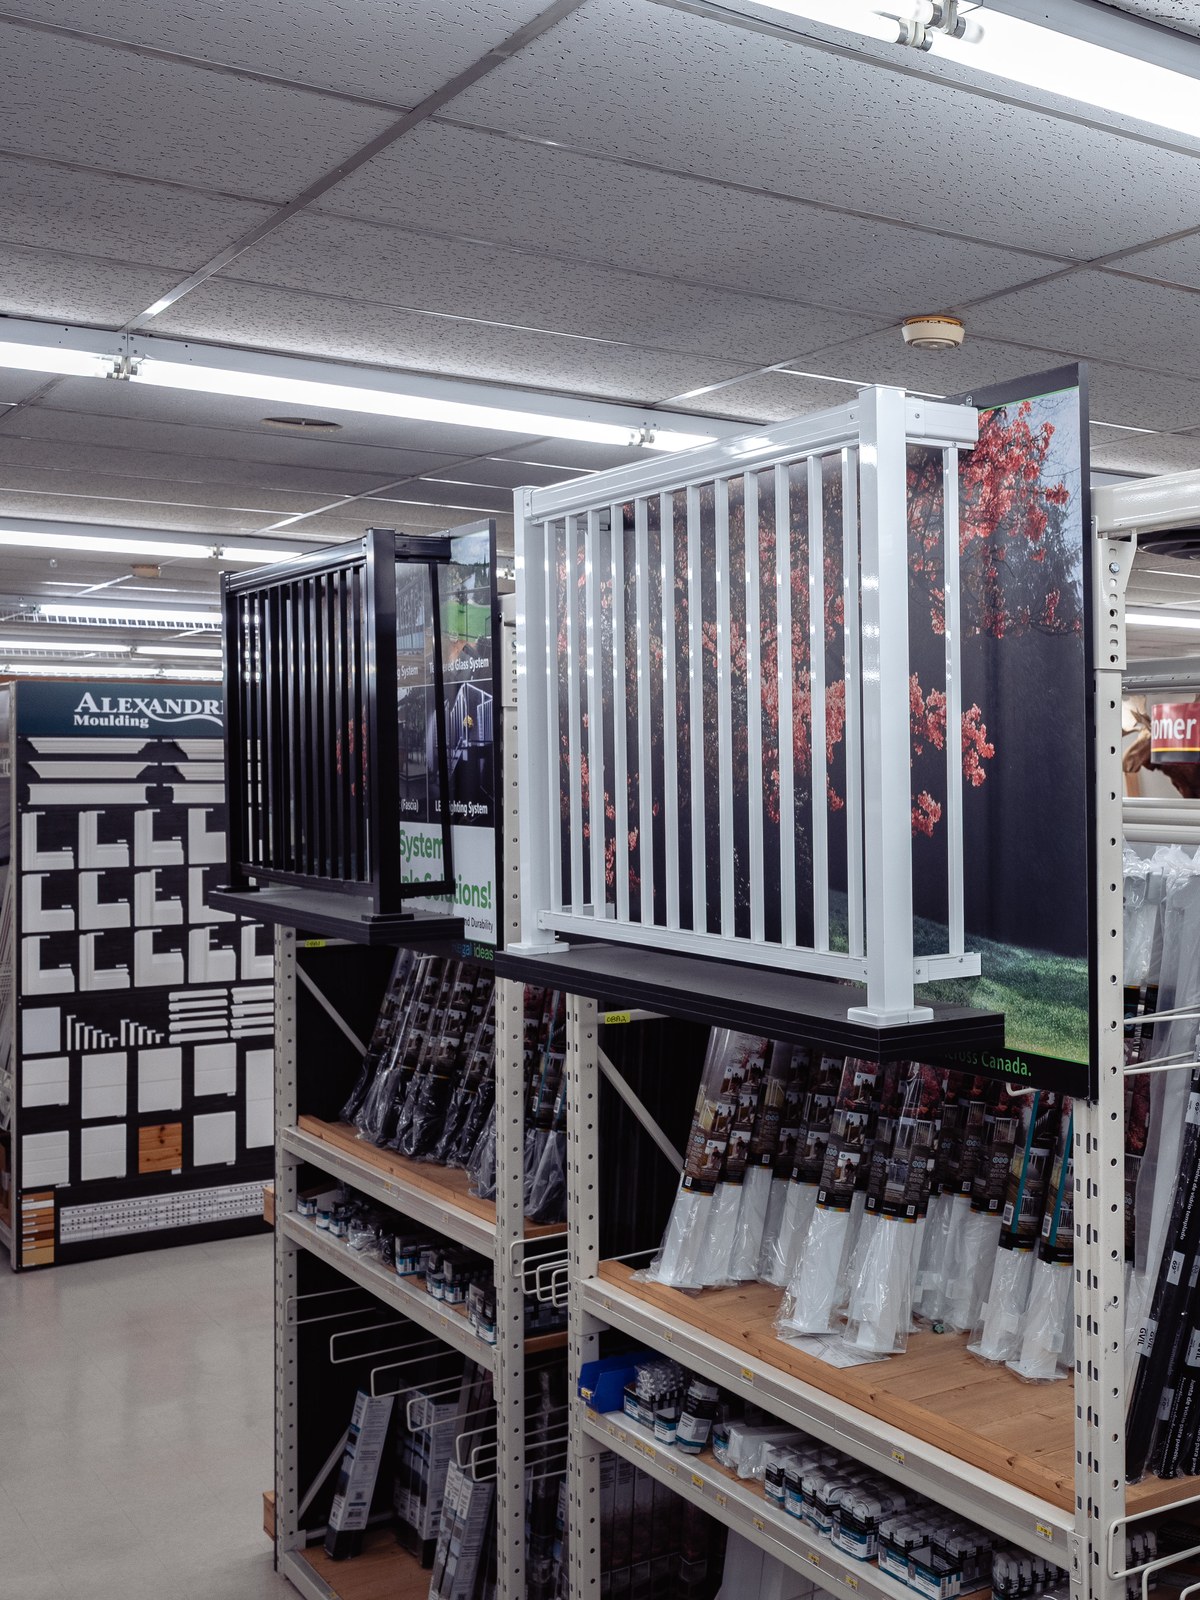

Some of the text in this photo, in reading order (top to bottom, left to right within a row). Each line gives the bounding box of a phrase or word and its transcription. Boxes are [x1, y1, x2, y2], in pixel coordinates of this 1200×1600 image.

[401, 665, 418, 678] System
[454, 657, 489, 673] Glass System
[73, 714, 149, 729] Moulding
[401, 801, 419, 813] (Fascia)
[467, 802, 488, 815] System
[471, 919, 494, 934] Durability
[473, 943, 494, 961] ideas
[981, 1051, 1032, 1077] Canada.
[1190, 1183, 1199, 1191] de
[1187, 1191, 1197, 1210] vidrio
[1179, 1210, 1191, 1241] templado
[1137, 1327, 1147, 1346] GVIL
[1187, 1379, 1196, 1397] Junta
[1184, 1397, 1192, 1406] de
[1177, 1424, 1186, 1438] para
[1192, 1443, 1200, 1458] para
